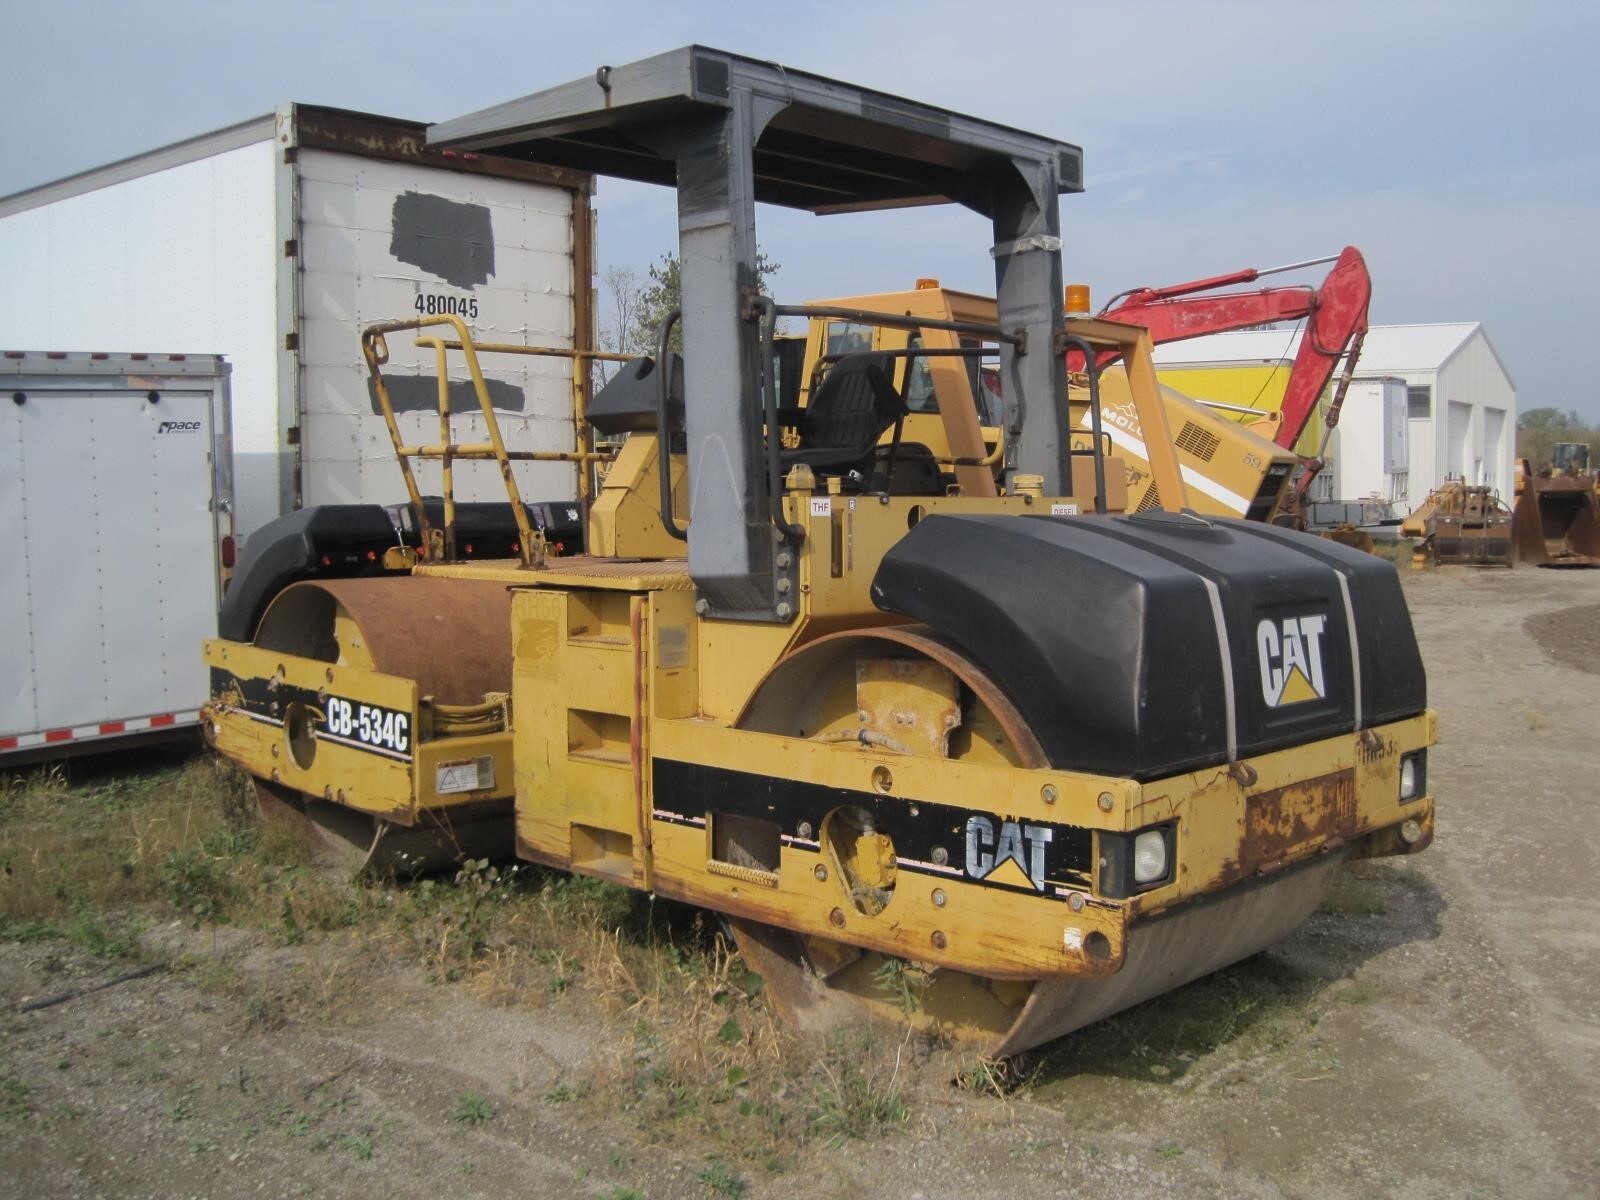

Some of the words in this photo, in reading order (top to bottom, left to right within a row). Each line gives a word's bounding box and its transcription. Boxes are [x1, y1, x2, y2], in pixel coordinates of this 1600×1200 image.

[415, 293, 478, 318] 480045
[813, 502, 829, 512] THF
[1257, 615, 1325, 707] CAT
[328, 697, 407, 751] CB-534C
[966, 815, 1052, 891] CAT
